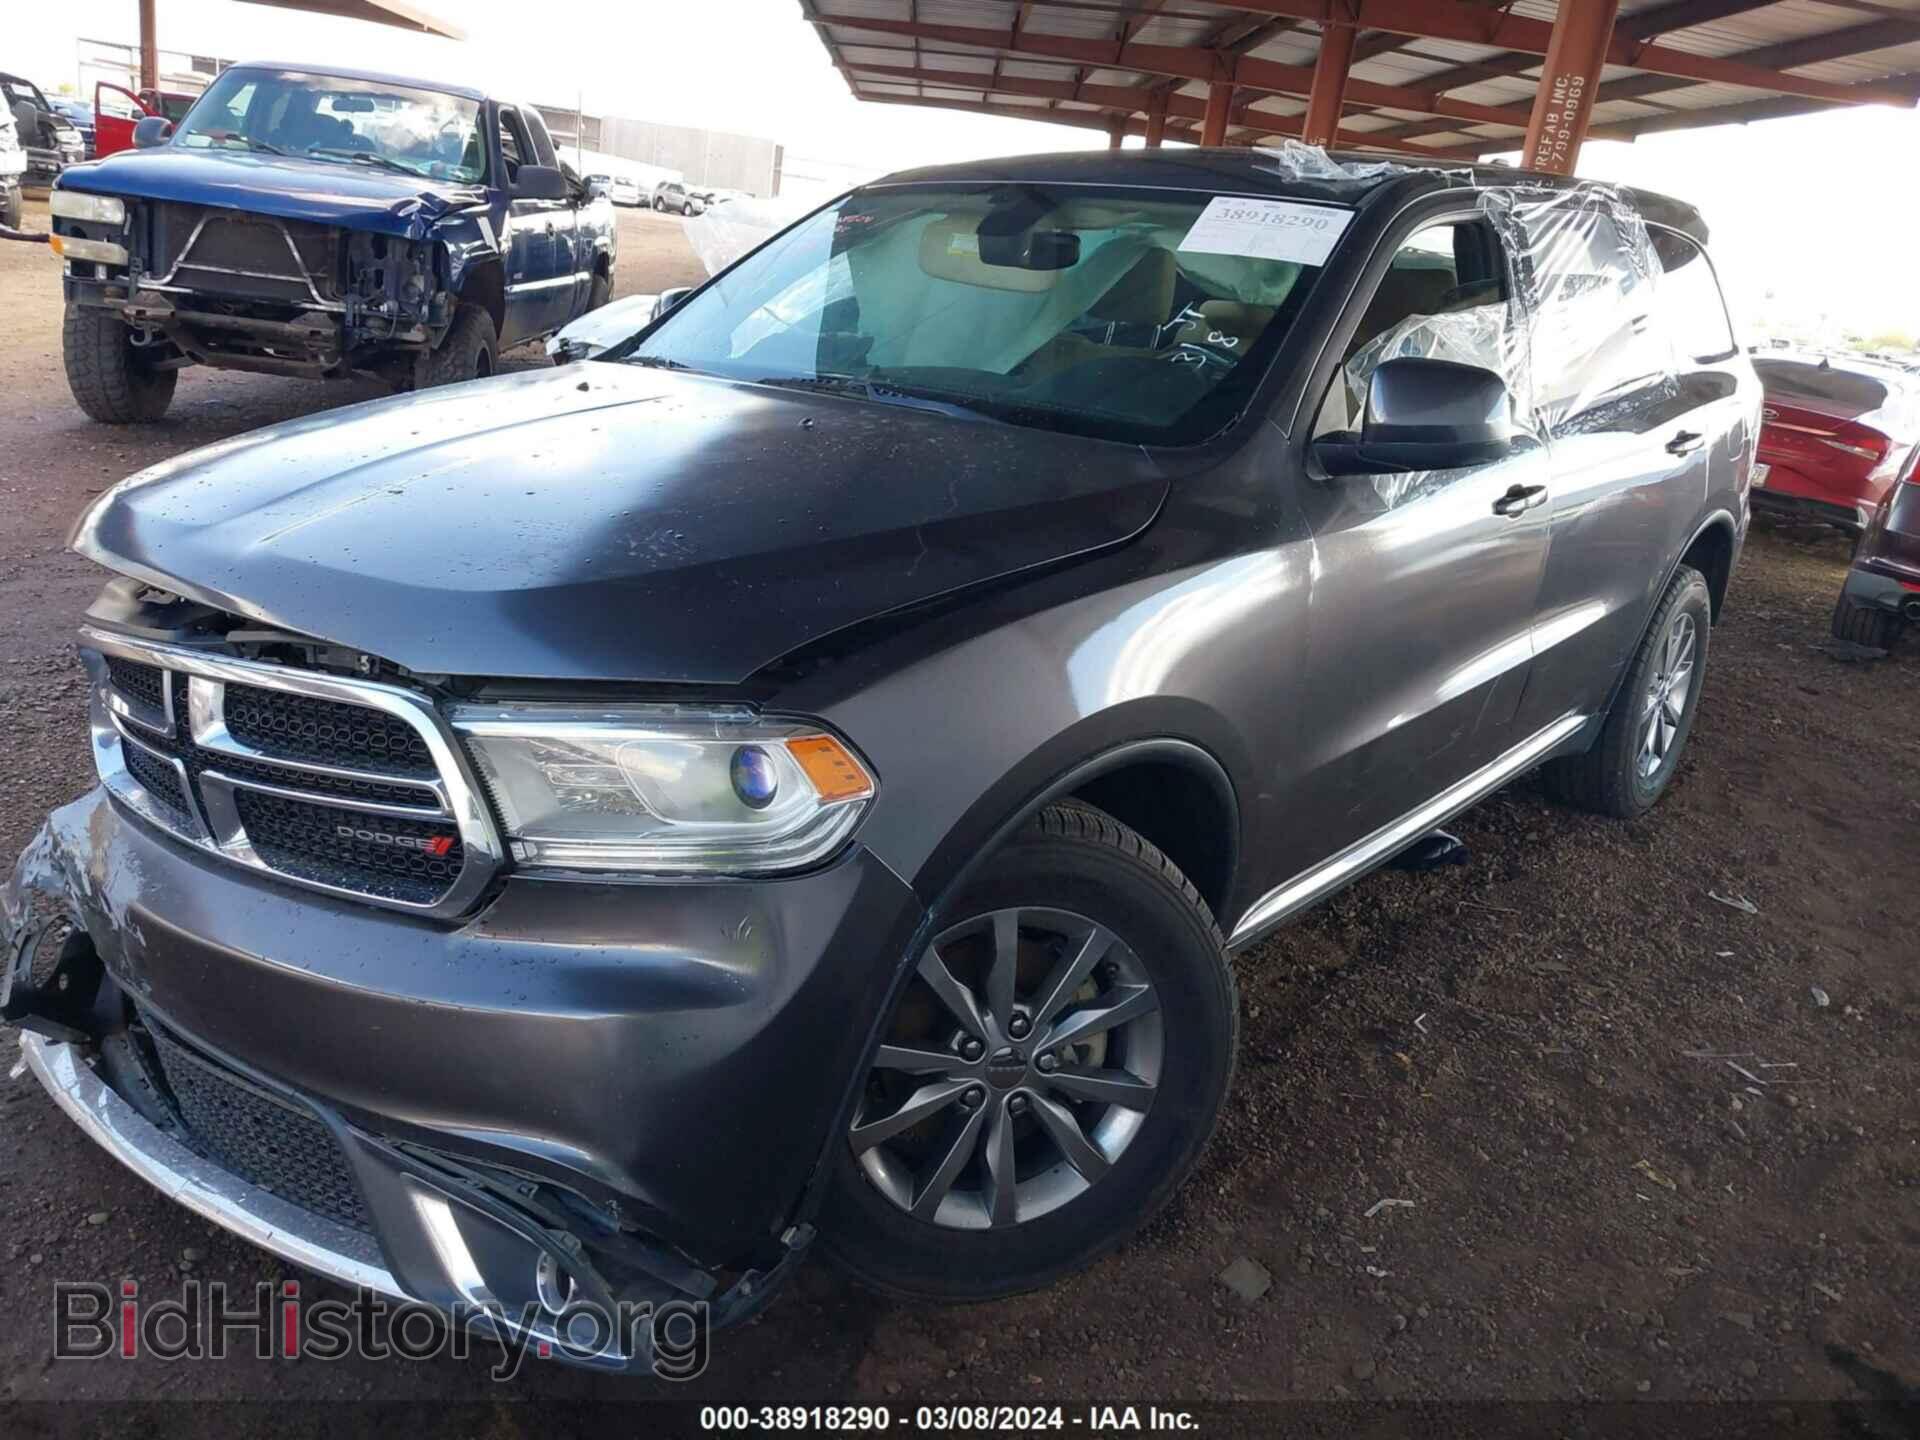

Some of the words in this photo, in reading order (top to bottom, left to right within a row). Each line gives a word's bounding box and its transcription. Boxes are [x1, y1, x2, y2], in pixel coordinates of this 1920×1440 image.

[1535, 112, 1560, 170] REFAB
[1550, 73, 1571, 105] INC.
[1215, 207, 1330, 231] 38918290
[337, 825, 436, 849] DODGE
